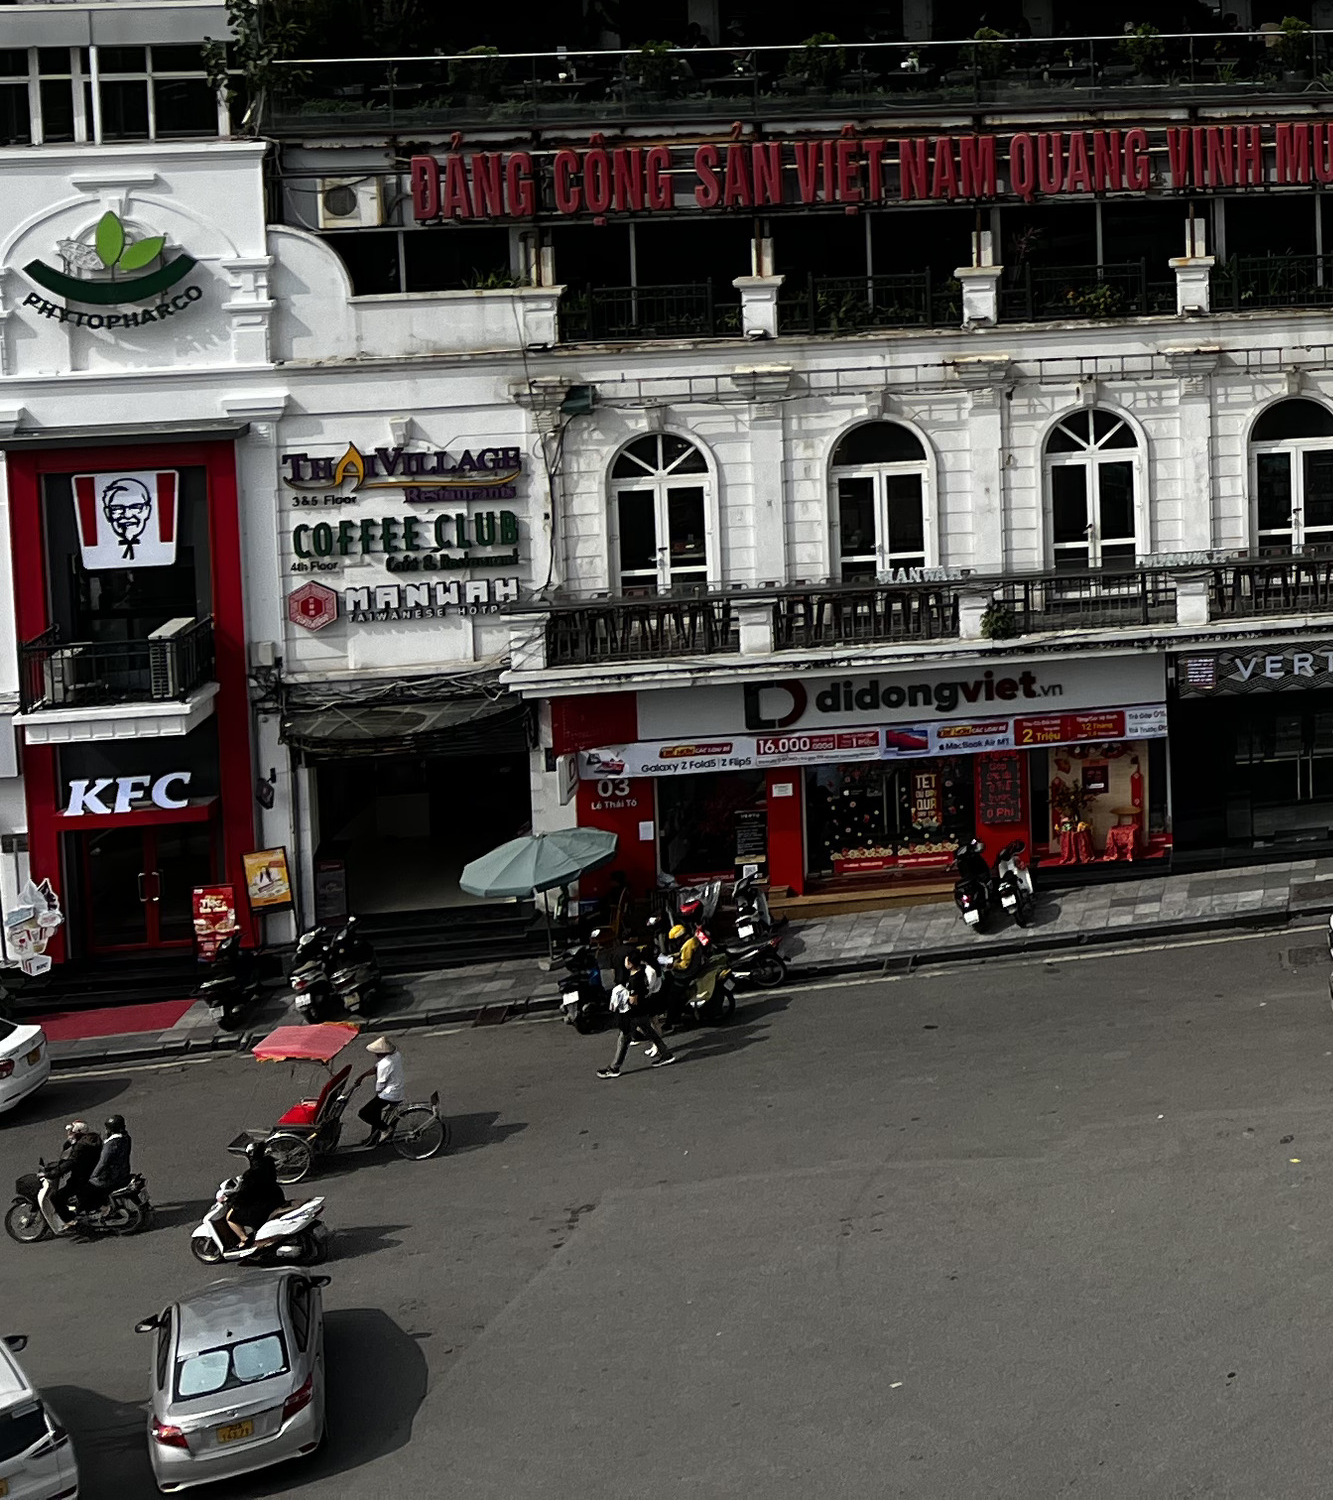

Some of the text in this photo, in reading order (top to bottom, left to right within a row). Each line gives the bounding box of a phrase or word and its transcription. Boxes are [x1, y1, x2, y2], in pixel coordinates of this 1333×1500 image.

[410, 131, 536, 221] ĐẢNG
[554, 132, 673, 227] CỘNG
[694, 120, 783, 209] SẢN
[796, 123, 888, 216] VIỆT
[900, 135, 998, 201] NAM
[1009, 127, 1151, 203] QUANG
[1166, 124, 1263, 188] VINH
[22, 285, 203, 329] PHYTOPHARCO
[323, 494, 357, 506] Floor
[403, 484, 516, 504] Restaurants
[293, 509, 519, 559] COFFEE CLUB
[310, 560, 338, 572] Floor
[345, 577, 520, 612] MANWAH
[348, 607, 446, 623] TAIWANESE
[815, 670, 1064, 714] didongviet.vn
[758, 737, 811, 754] 16.000
[945, 740, 983, 750] MacBook
[984, 739, 996, 747] Air
[1022, 728, 1034, 743] 2
[641, 762, 679, 773] Galaxy
[681, 761, 687, 769] Z
[721, 758, 728, 767] Z
[64, 771, 192, 818] KFC
[596, 777, 631, 798] 03
